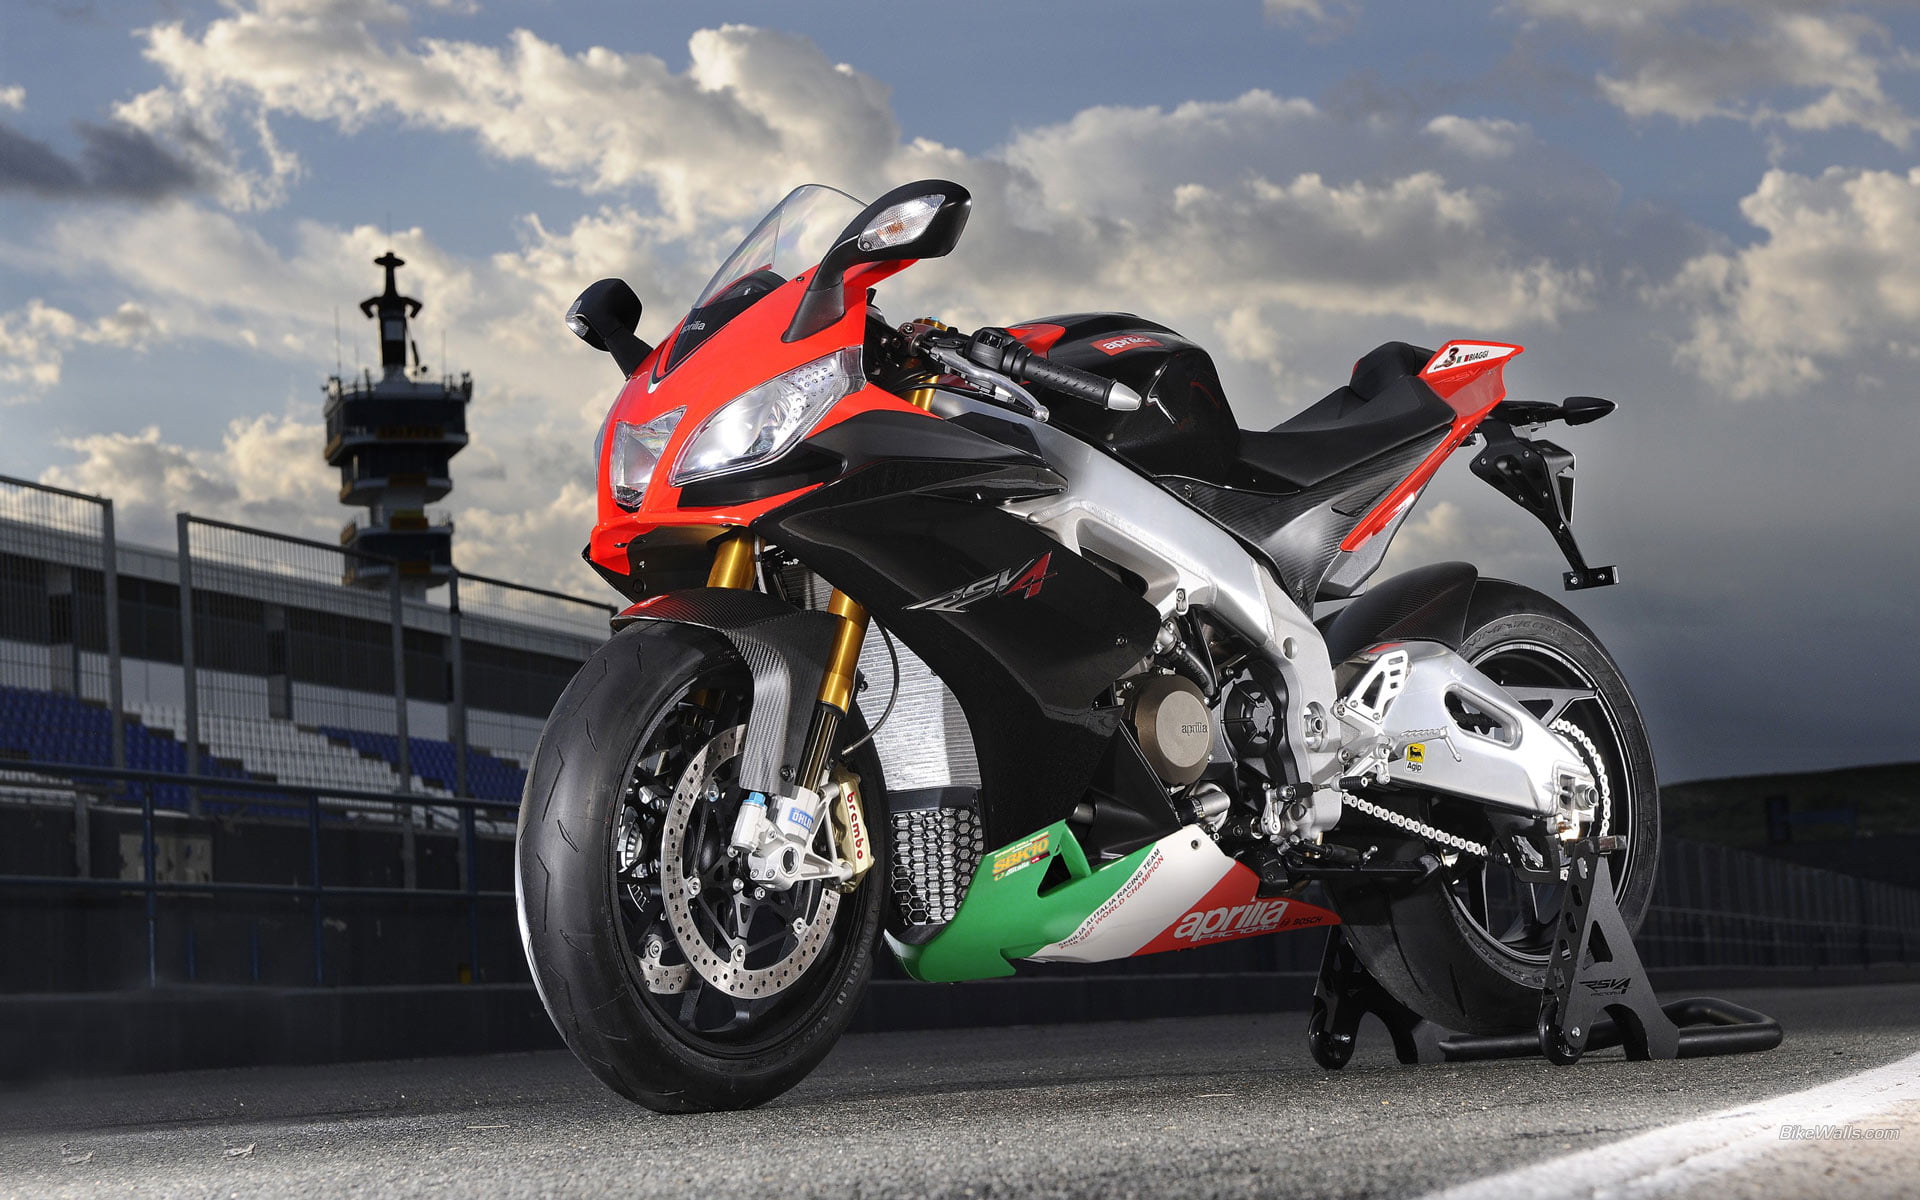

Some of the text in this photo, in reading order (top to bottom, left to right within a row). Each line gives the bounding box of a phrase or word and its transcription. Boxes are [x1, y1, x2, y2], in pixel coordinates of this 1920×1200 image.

[1181, 721, 1208, 736] aprilia
[1406, 761, 1422, 773] Agip
[846, 791, 865, 860] brembo
[1086, 898, 1117, 927] ALITALIA
[1117, 870, 1144, 899] RACING
[1143, 848, 1161, 871] TEAM
[1094, 897, 1125, 925] WORLD
[1126, 855, 1165, 899] CHAMPION
[1173, 896, 1290, 942] aprilia
[1292, 915, 1324, 926] BOSCH
